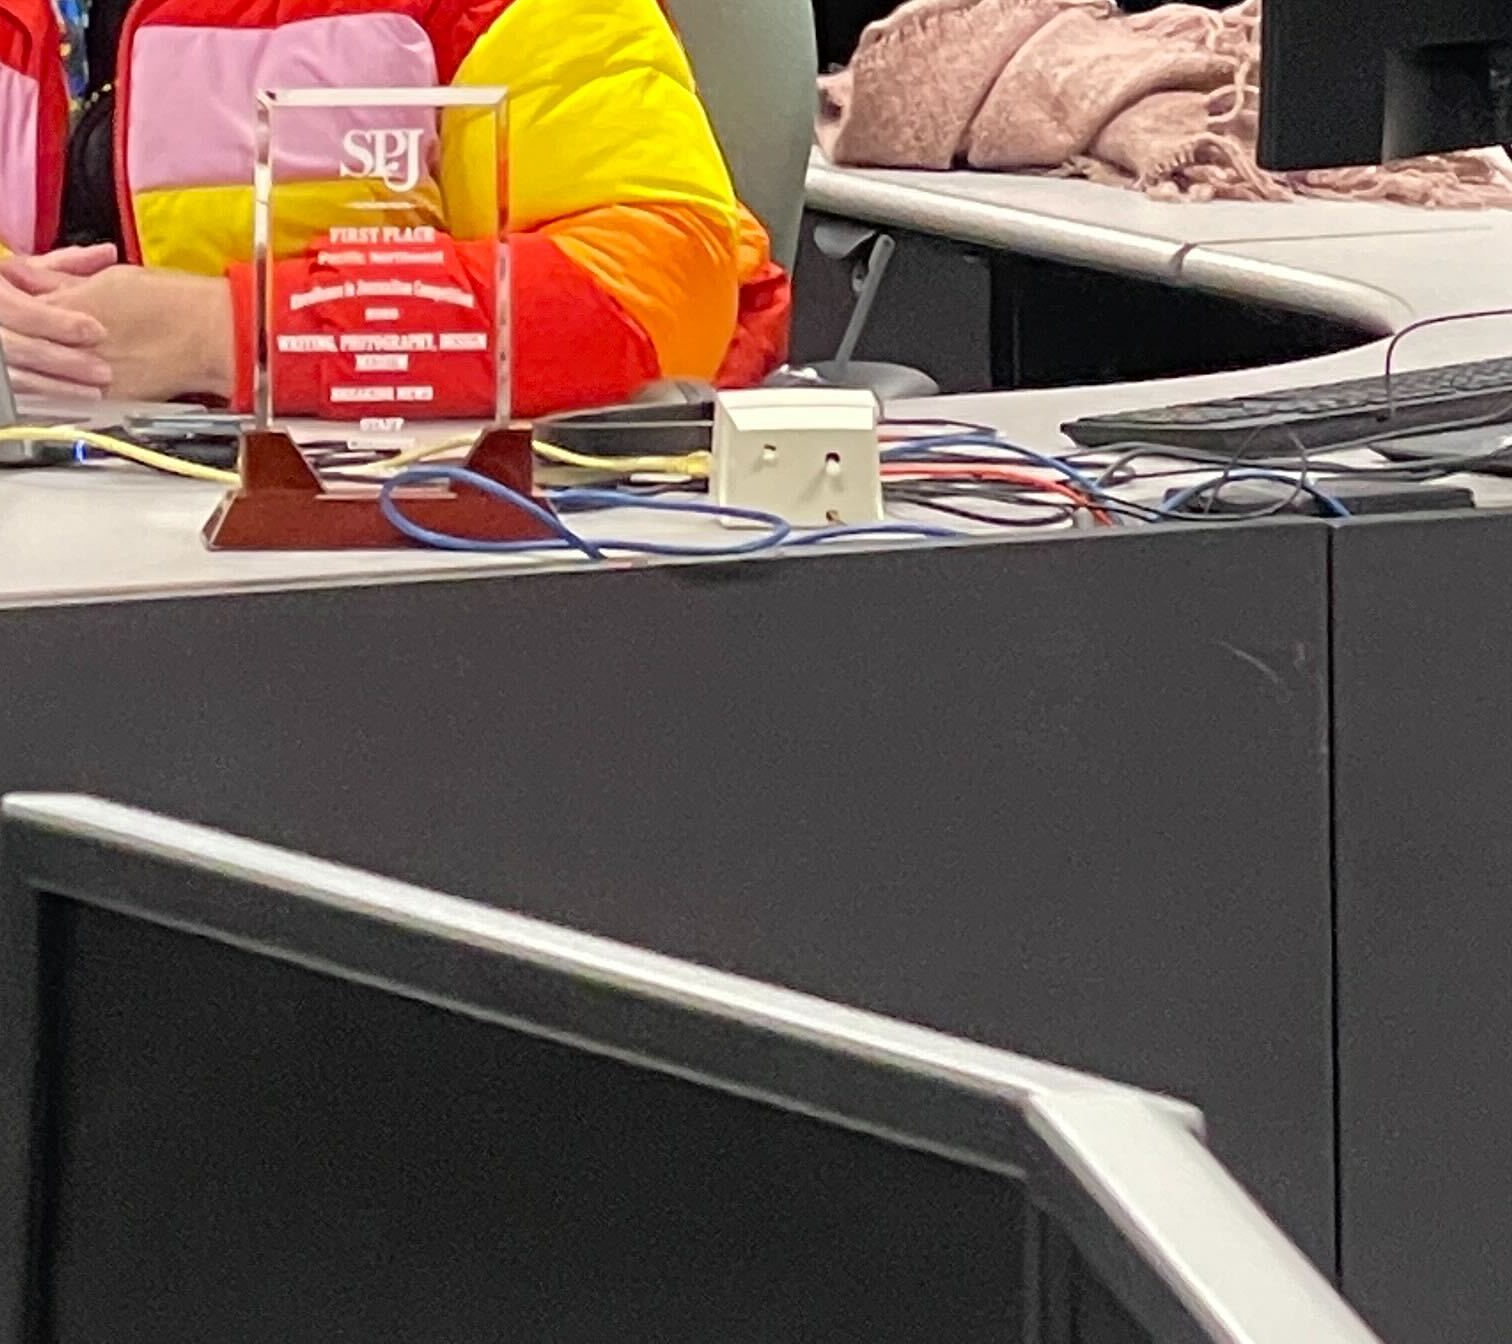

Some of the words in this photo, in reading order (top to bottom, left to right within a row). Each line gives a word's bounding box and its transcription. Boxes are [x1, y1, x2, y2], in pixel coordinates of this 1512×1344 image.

[339, 128, 425, 192] SPJ
[329, 225, 379, 244] FIRST
[382, 224, 436, 244] PLACE
